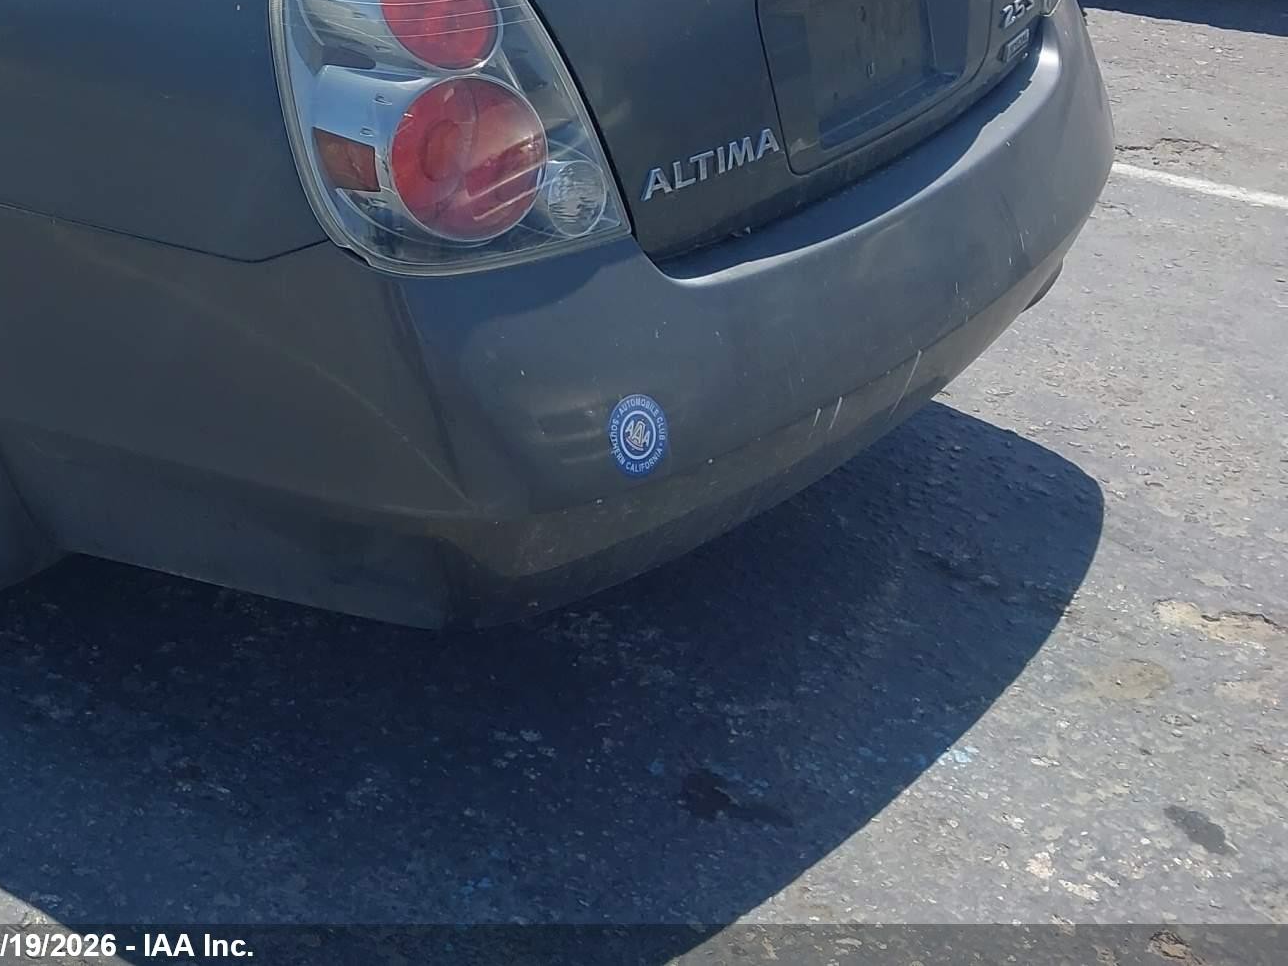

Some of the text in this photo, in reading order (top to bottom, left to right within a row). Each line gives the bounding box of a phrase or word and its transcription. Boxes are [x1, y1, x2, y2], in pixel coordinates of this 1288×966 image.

[641, 128, 780, 202] ALTIMA
[618, 397, 667, 441] AUTOMOBILE CLUB
[625, 420, 650, 448] AAA
[625, 447, 663, 473] CALIFORNIA
